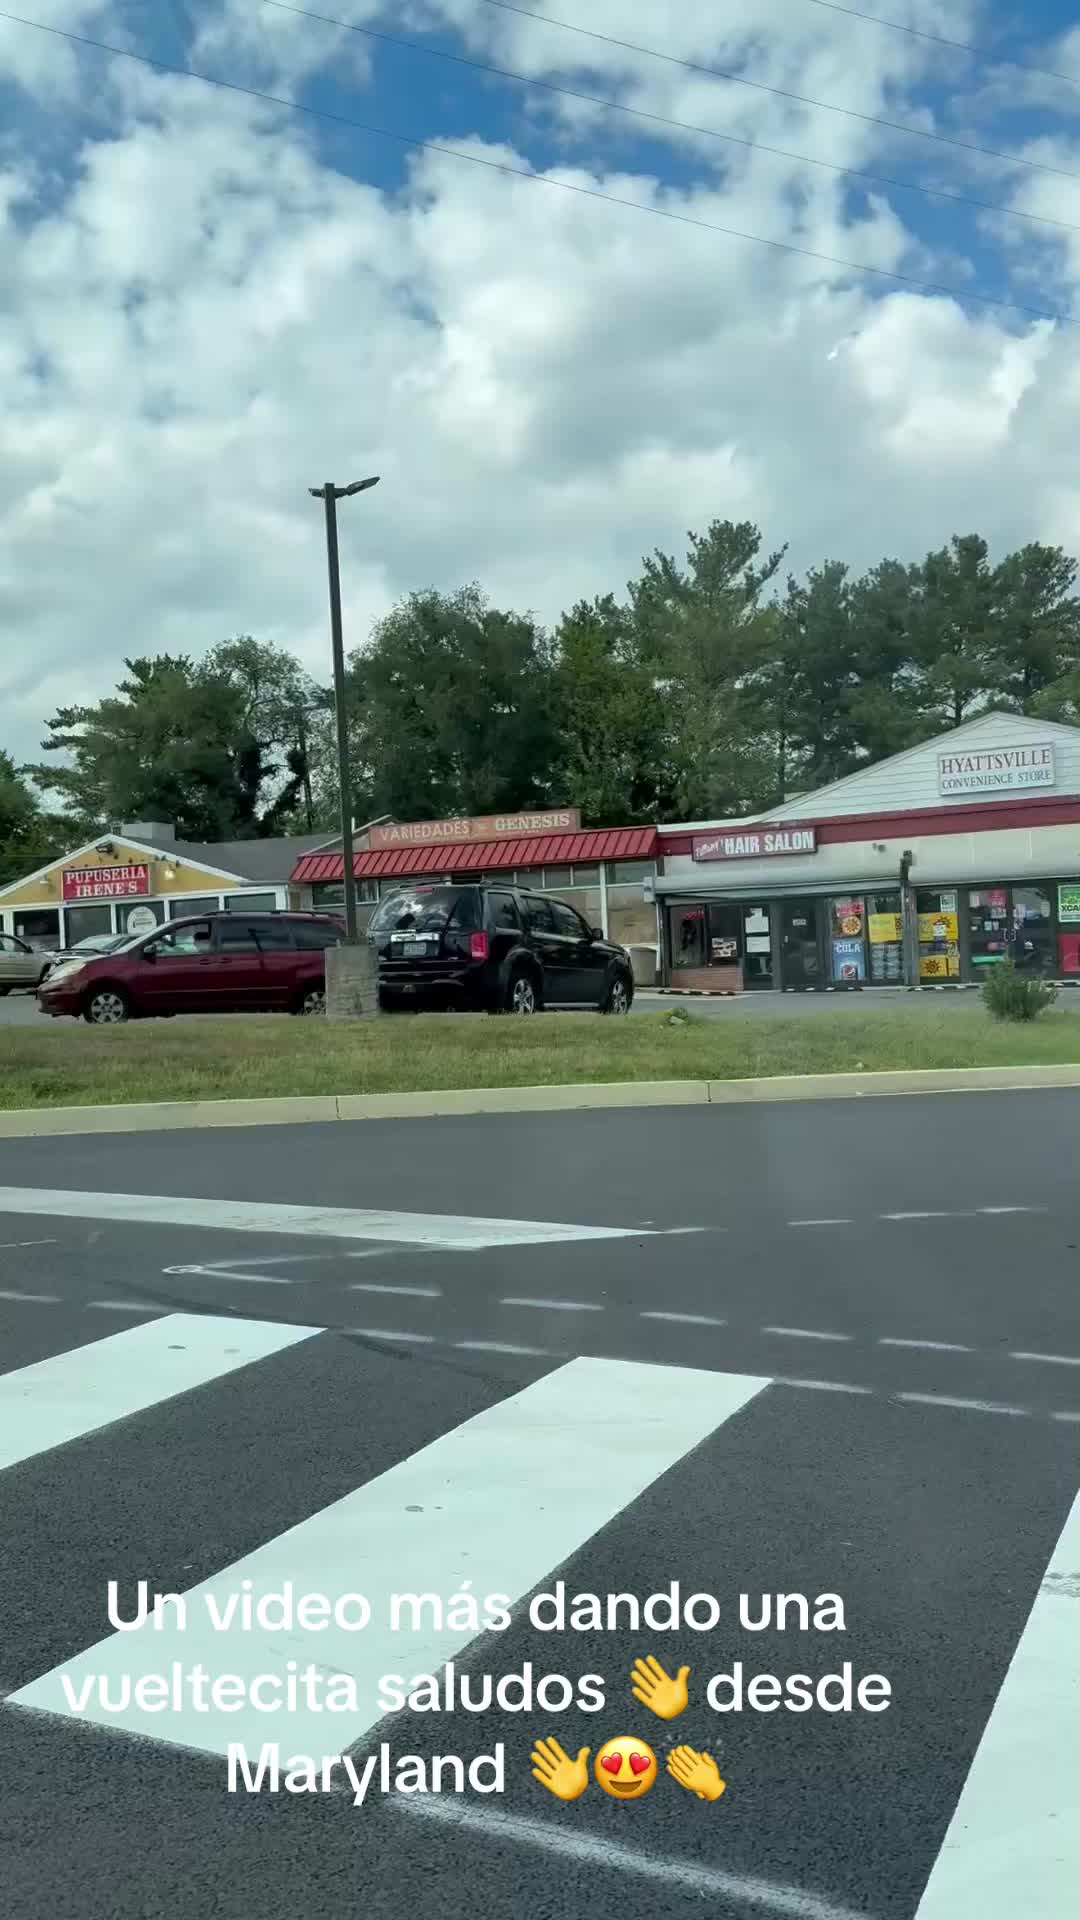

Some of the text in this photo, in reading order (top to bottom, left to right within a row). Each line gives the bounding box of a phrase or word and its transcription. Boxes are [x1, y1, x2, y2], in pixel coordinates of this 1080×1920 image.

[941, 749, 1051, 774] HYATTSVILLE
[942, 769, 1050, 789] CONVENIENCE STORE
[379, 820, 470, 841] VARIEDADES
[495, 813, 570, 831] GENESIS
[724, 835, 760, 855] HAIR
[763, 831, 814, 852] SALON
[65, 866, 146, 885] PUPUSERIA
[1061, 904, 1080, 912] XCA
